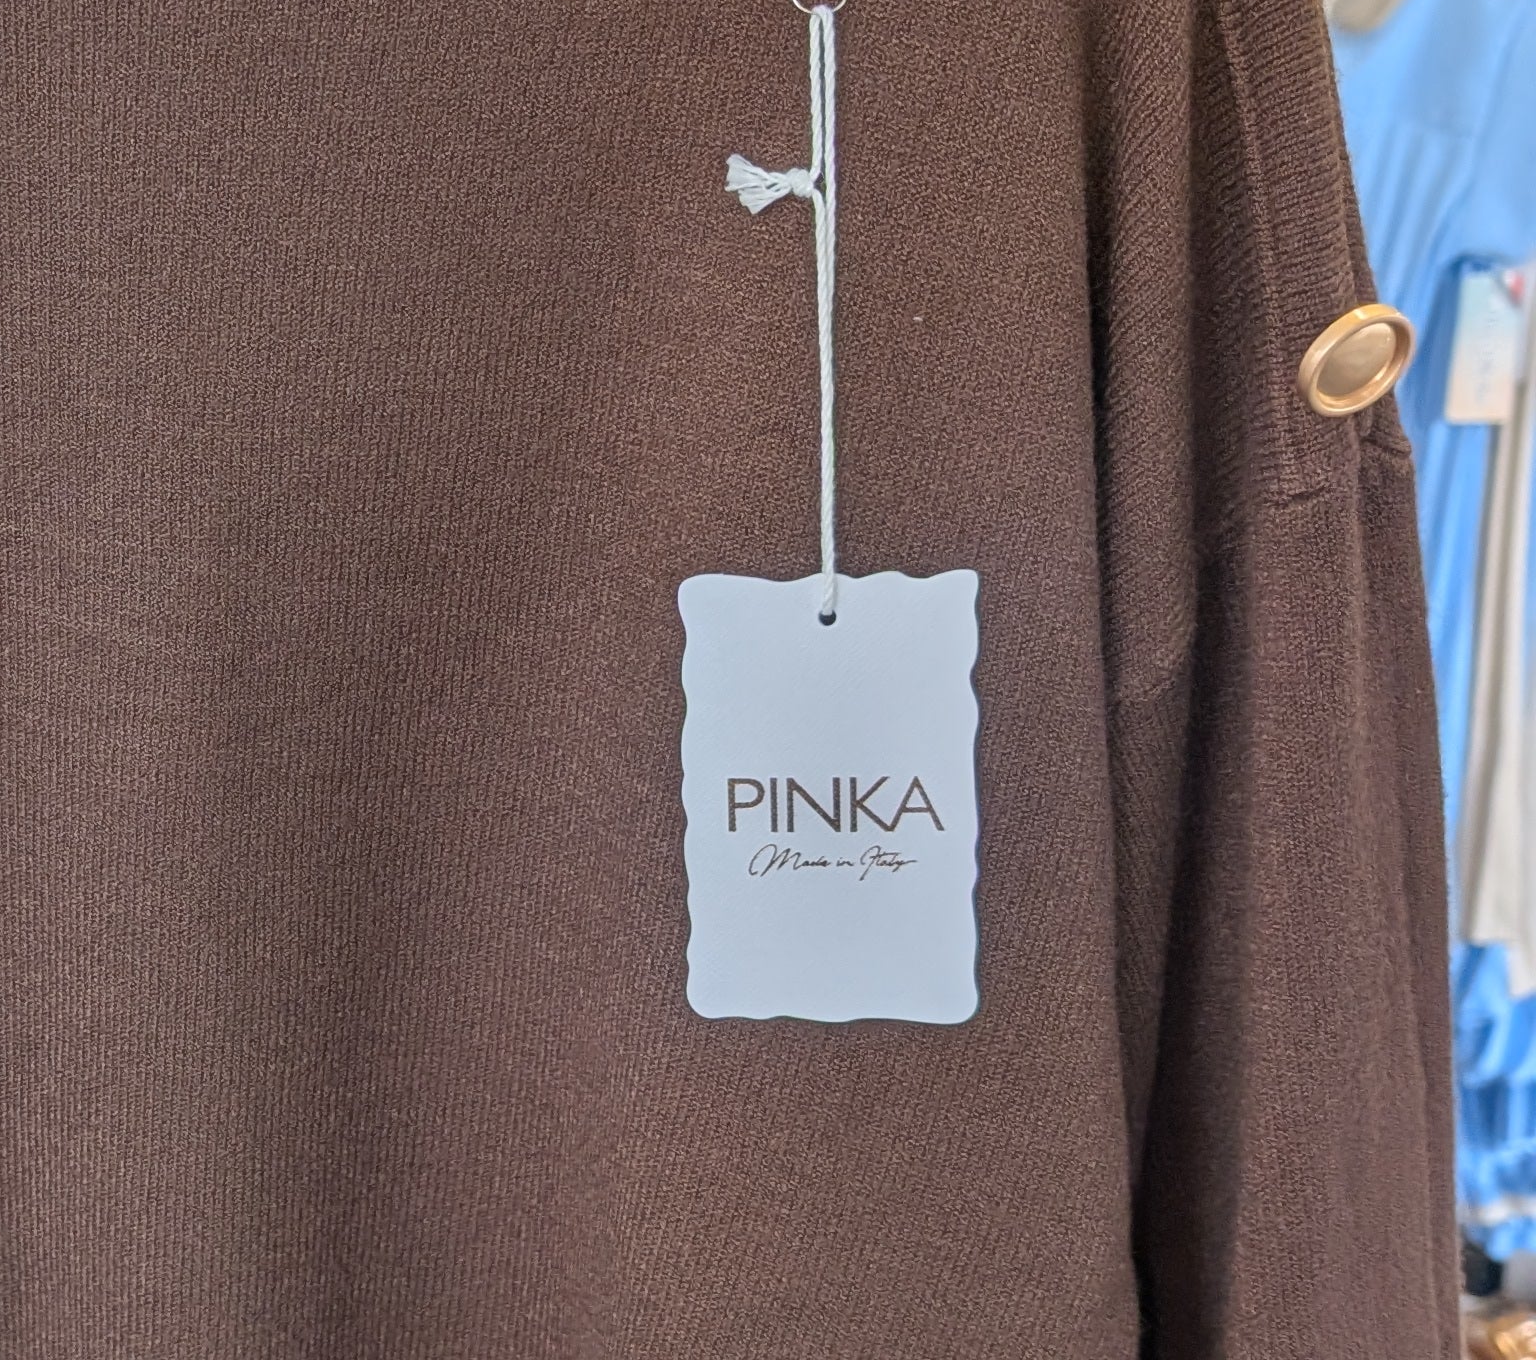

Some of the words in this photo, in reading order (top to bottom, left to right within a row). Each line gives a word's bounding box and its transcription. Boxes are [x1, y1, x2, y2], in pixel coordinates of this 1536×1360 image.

[726, 775, 946, 834] PINKA
[747, 843, 833, 878] Made
[835, 856, 856, 868] in
[858, 844, 919, 882] Italy
